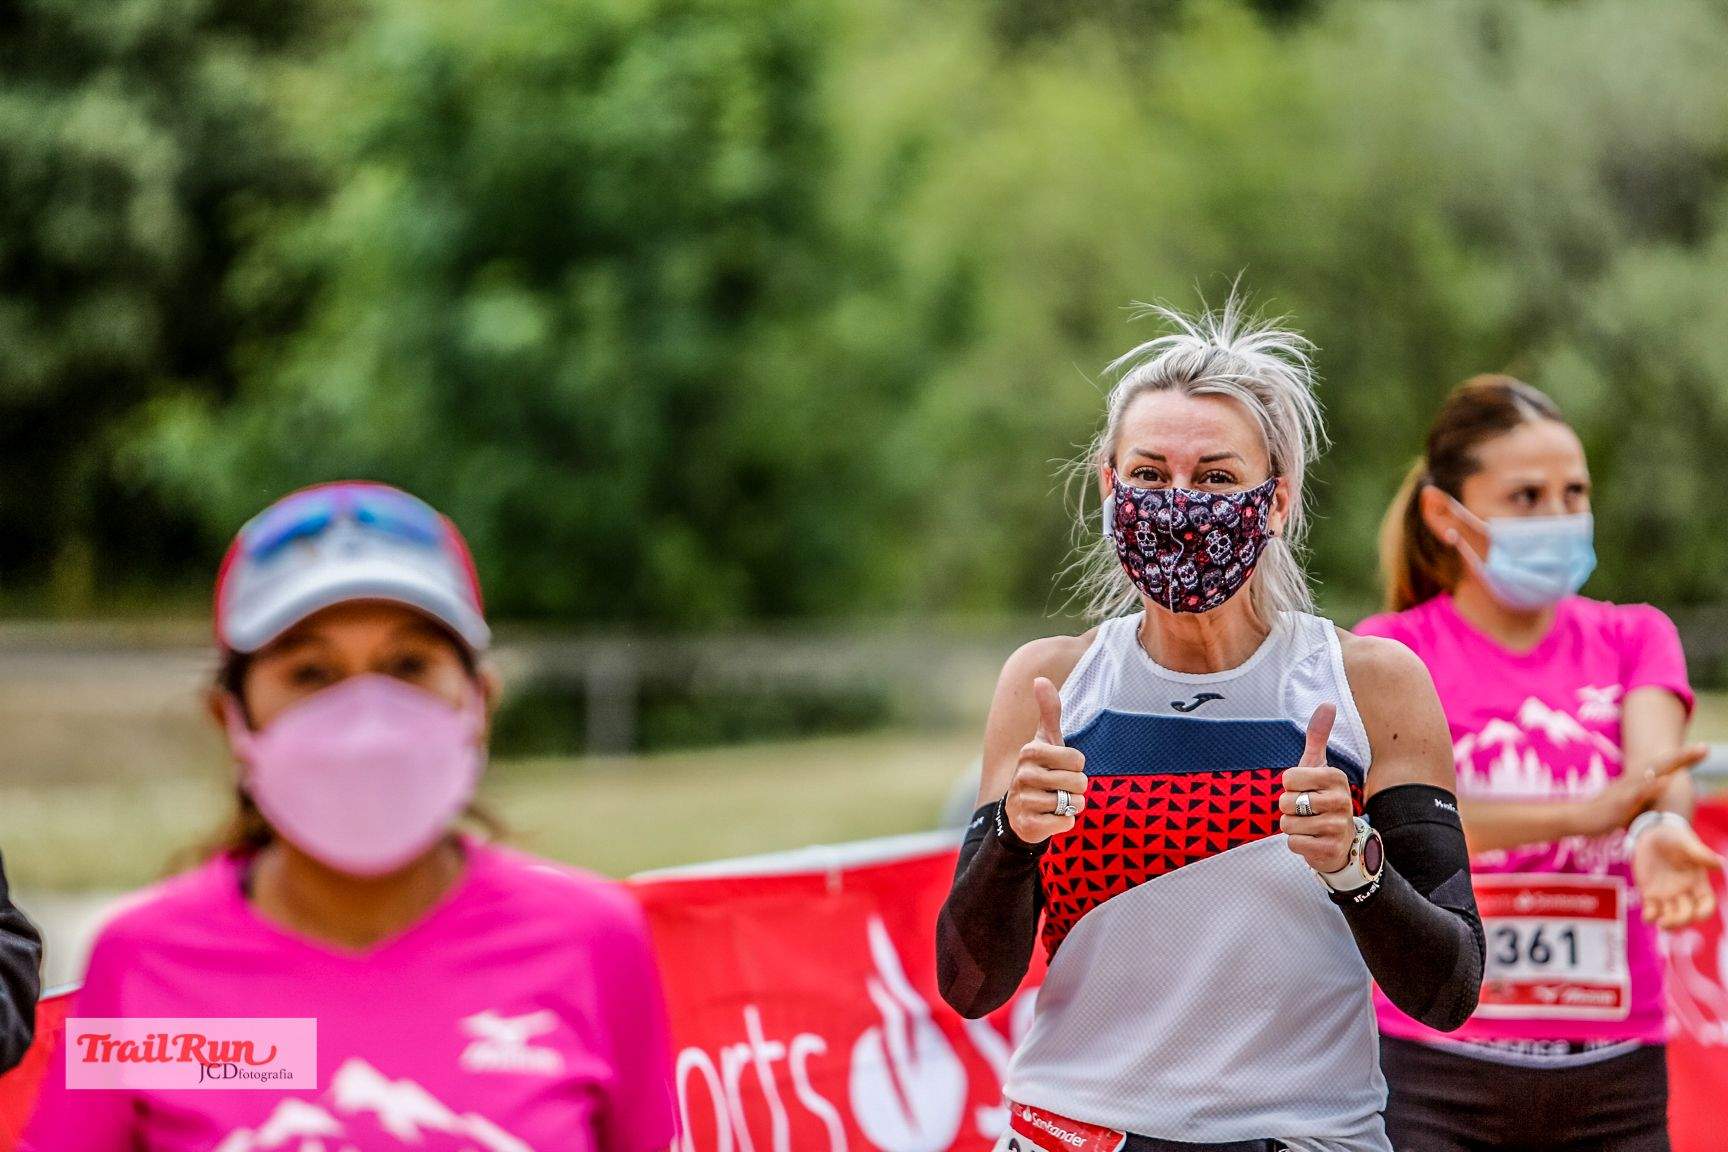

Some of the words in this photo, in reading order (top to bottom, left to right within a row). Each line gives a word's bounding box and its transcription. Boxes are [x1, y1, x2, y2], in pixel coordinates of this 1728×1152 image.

[1495, 924, 1577, 966] 361
[671, 1004, 847, 1152] orts
[1031, 1111, 1087, 1148] Santander
